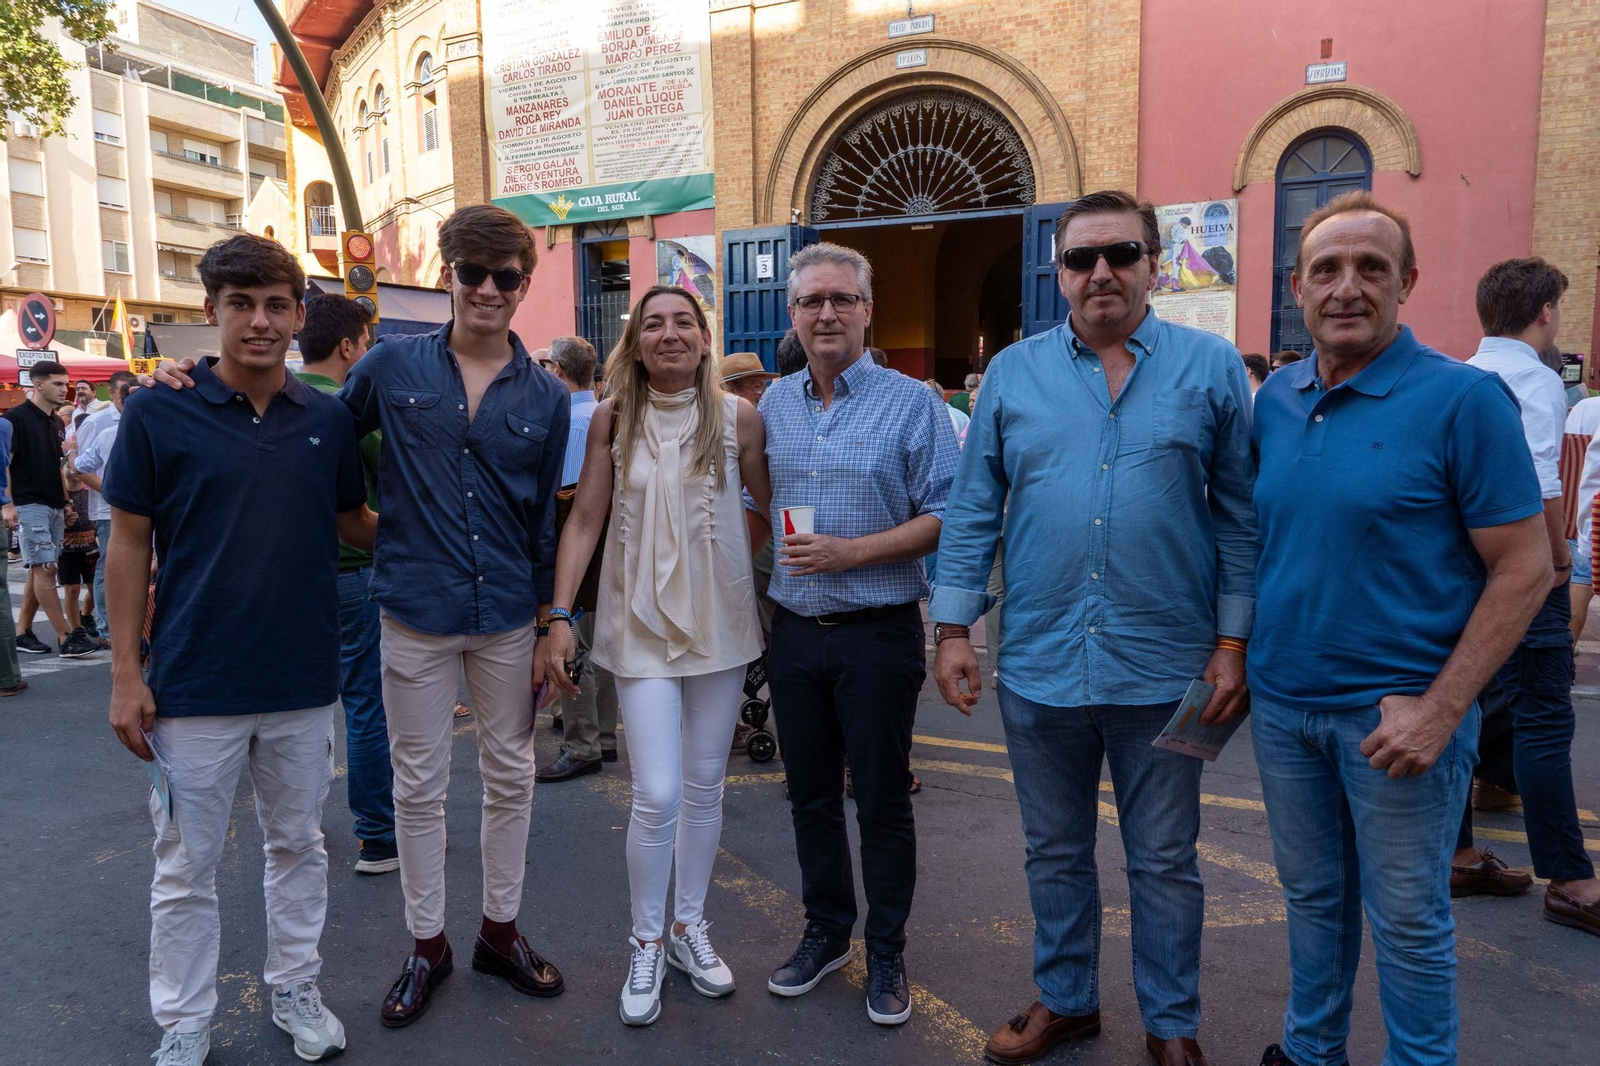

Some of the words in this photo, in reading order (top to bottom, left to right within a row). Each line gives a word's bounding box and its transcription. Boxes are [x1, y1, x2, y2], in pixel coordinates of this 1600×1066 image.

[604, 20, 623, 28] JUAN
[625, 16, 650, 25] PEDRO
[597, 28, 633, 42] EMILIO
[635, 25, 650, 37] DE
[601, 39, 638, 53] BORJA
[605, 49, 642, 64] MARCO
[653, 56, 691, 65] AGOSTO
[494, 59, 530, 74] CRISTIAN
[502, 68, 535, 83] CARLOS
[537, 61, 571, 76] TIRADO
[611, 70, 638, 79] Corrida
[613, 77, 635, 85] LORETO
[636, 73, 660, 81] CHARRO
[661, 70, 686, 78] SANTOS
[498, 84, 527, 94] VIERNES
[545, 75, 577, 85] AGOSTO
[597, 82, 657, 99] MORANTE
[662, 83, 693, 91] PUEBLA
[508, 89, 532, 98] Corrida
[519, 91, 559, 102] TORREALTA
[603, 96, 642, 110] DANIEL
[645, 90, 684, 104] LUQUE
[506, 97, 569, 116] MANZANARES
[605, 108, 633, 122] JUAN
[636, 102, 684, 117] ORTEGA
[515, 113, 541, 126] ROCA
[543, 109, 561, 121] REY
[630, 119, 659, 127] ONLINE
[498, 127, 523, 140] DAVID
[526, 125, 537, 135] DE
[539, 117, 581, 133] MIRANDA
[645, 123, 669, 131] JUNIO
[502, 140, 533, 149] DOMINGO
[551, 131, 582, 141] AGOSTO
[509, 146, 533, 154] Corrida
[543, 140, 571, 149] Rejones
[507, 162, 540, 174] SERGIO
[543, 157, 575, 169] GALÁN
[505, 173, 533, 184] DIEGO
[535, 167, 579, 180] VENTURA
[541, 176, 583, 189] ROMERO
[578, 195, 603, 207] CAJA
[605, 190, 641, 204] RURAL
[1191, 223, 1234, 234] HUELVA
[761, 264, 768, 273] 3
[19, 351, 42, 359] EXCEPTO
